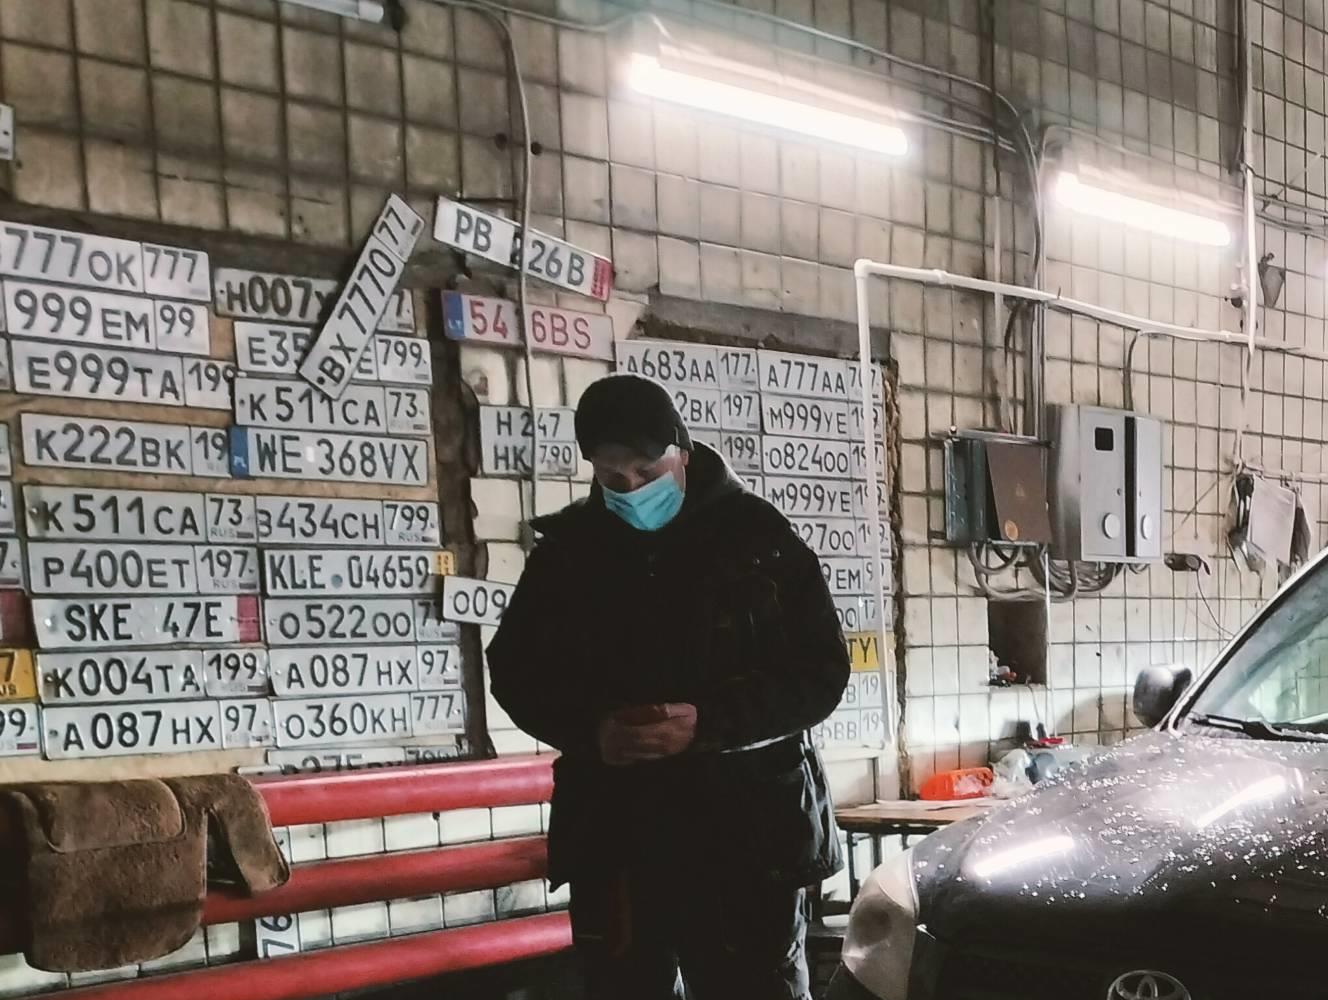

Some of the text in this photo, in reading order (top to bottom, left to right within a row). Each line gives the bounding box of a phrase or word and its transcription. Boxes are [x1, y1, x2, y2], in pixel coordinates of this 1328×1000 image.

[378, 206, 406, 246] 77
[454, 208, 492, 253] PB
[145, 247, 198, 283] 777
[14, 289, 196, 344] 999ЕМ 99
[378, 339, 423, 369] 799
[720, 352, 752, 376] 177
[28, 350, 180, 401] Е999ТА
[767, 359, 847, 395] А777АА
[249, 386, 418, 427] К511СА 73
[723, 394, 754, 418] 197
[769, 401, 847, 435] М999УЕ
[35, 422, 186, 470] К222ВК
[256, 433, 302, 474] WE
[317, 438, 420, 481] 368VX
[724, 437, 755, 459] 199
[43, 493, 200, 536] К511СА
[209, 497, 244, 526] 73
[385, 503, 430, 532] 799
[771, 482, 851, 514] М999УЕ
[43, 549, 190, 588] Р400ЕТ
[200, 549, 249, 578] 197
[269, 554, 326, 590] KLE
[347, 555, 430, 590] 04659
[65, 601, 224, 641] SKE 47E
[52, 652, 257, 698] К004ТА 199
[286, 649, 449, 690] А087НХ 97
[413, 694, 455, 721] 777
[63, 704, 257, 752] А087НХ 97
